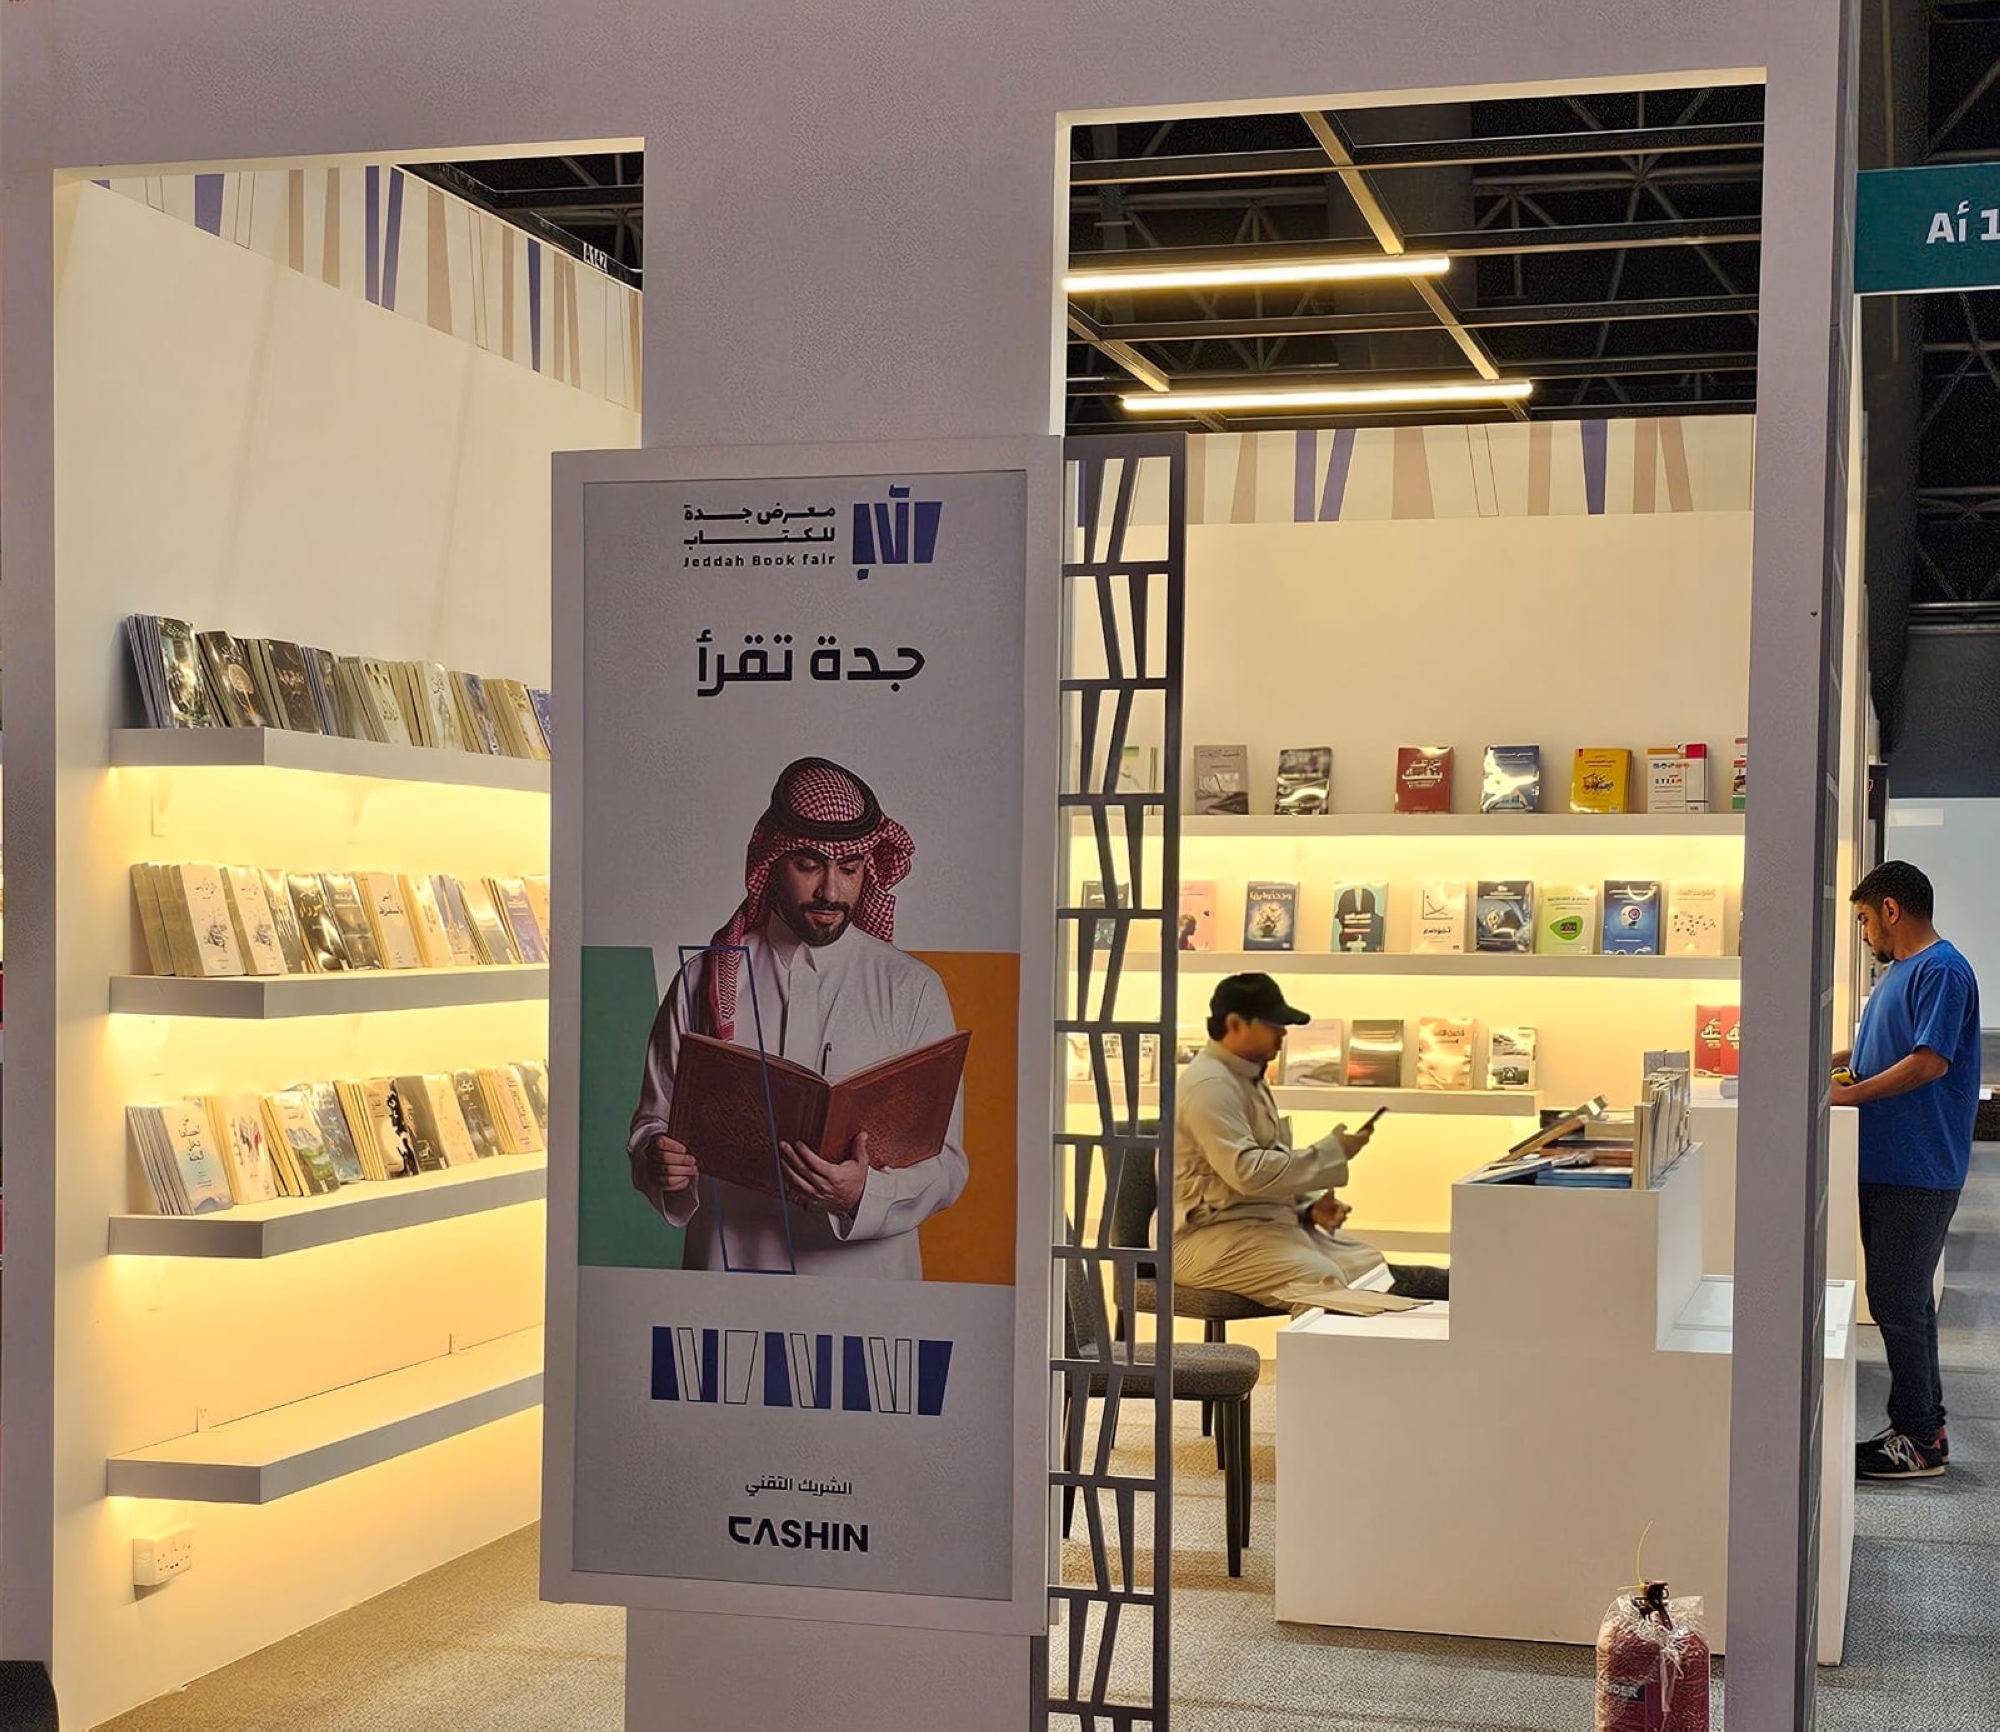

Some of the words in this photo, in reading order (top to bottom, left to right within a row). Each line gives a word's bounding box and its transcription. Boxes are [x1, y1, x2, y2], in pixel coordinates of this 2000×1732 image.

[684, 504, 753, 524] جدة
[756, 502, 836, 525] معرض
[683, 527, 836, 551] للكتاب
[683, 555, 744, 568] Jeddah
[752, 554, 795, 567] Book
[802, 552, 836, 566] fair
[695, 628, 793, 698] تقرأ
[809, 635, 926, 693] جدة
[745, 1474, 793, 1497] التقني
[798, 1476, 852, 1497] الشريك
[728, 1515, 869, 1553] CASHIN
